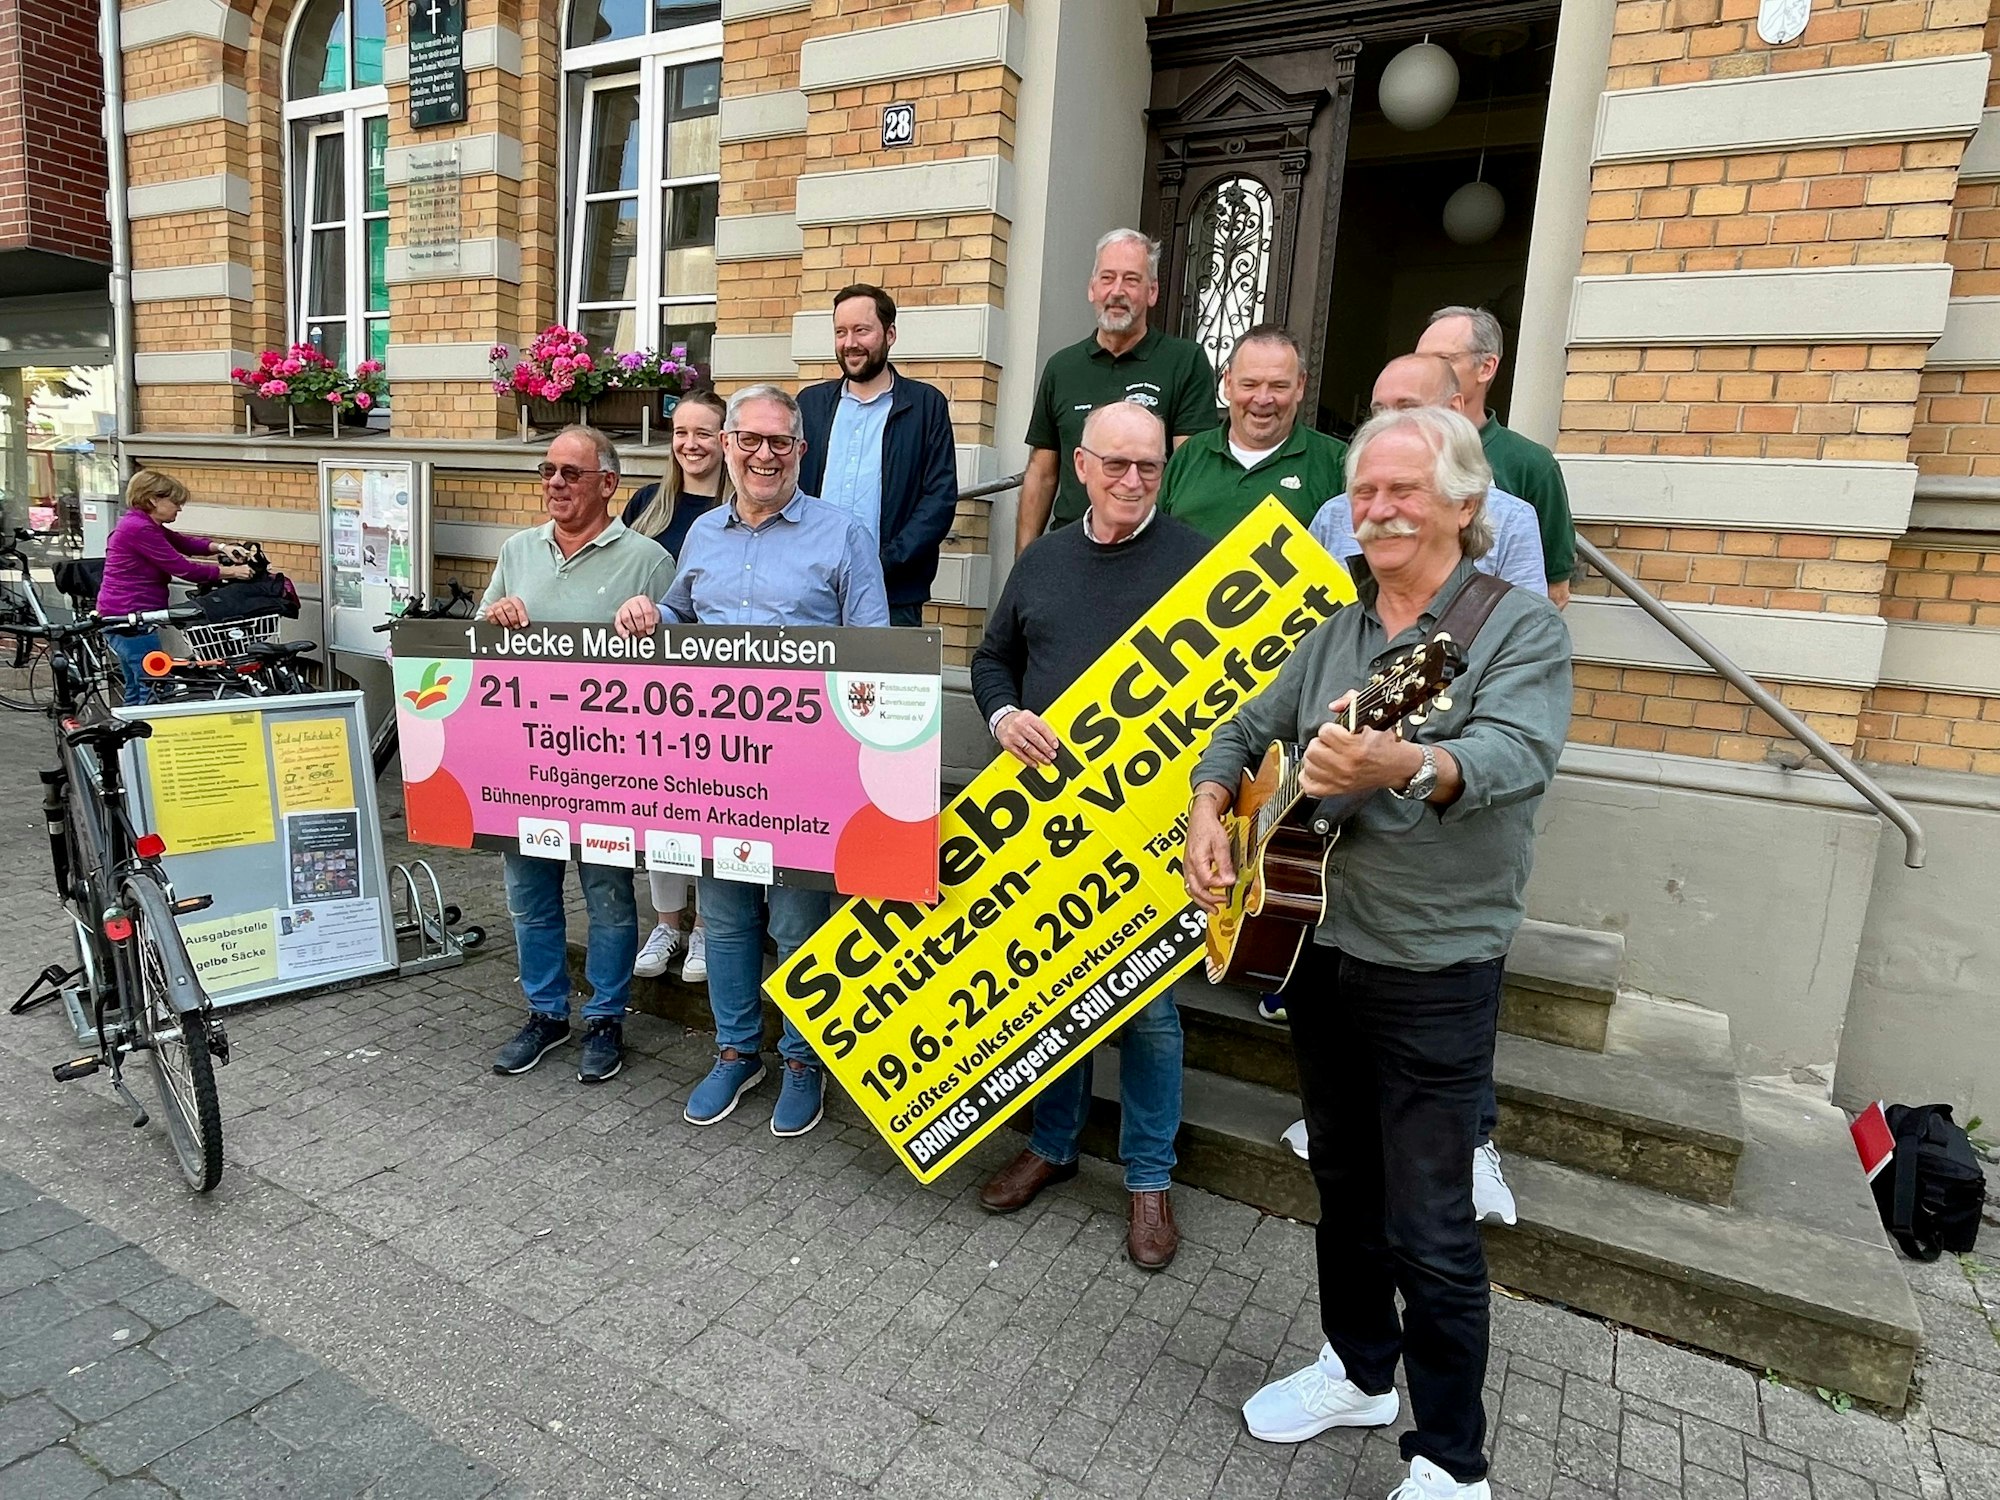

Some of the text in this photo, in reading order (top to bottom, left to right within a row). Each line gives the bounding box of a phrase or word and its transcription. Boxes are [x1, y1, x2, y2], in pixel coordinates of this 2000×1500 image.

[886, 110, 910, 141] 28
[465, 628, 488, 655] 1.
[496, 627, 574, 658] Jecke
[664, 629, 836, 665] Leverkusen
[480, 674, 538, 709] 21.
[579, 678, 823, 724] 22.06.2025
[522, 722, 773, 765] Täglich: 11-19 Uhr
[529, 765, 768, 800] Fußgängerzone Schlebusch
[786, 523, 1299, 1021] Schebuscher
[481, 786, 830, 836] Bühnenprogramm auf dem Arkadenplatz
[822, 584, 1344, 1060] Schützen- & Volksfest
[526, 831, 562, 848] avea
[586, 837, 630, 853] wupsi
[1143, 813, 1189, 858] Tägli
[185, 921, 268, 947] Ausgabestelle
[221, 940, 238, 952] für
[196, 956, 229, 972] gelbe
[231, 947, 267, 963] Säcke
[861, 849, 1140, 1102] 19.6.-22.6.2025
[889, 903, 1158, 1133] Größtes Volksfest Leverkusens
[909, 910, 1208, 1164] BRINGS Hörgerät Still Collins Sa
